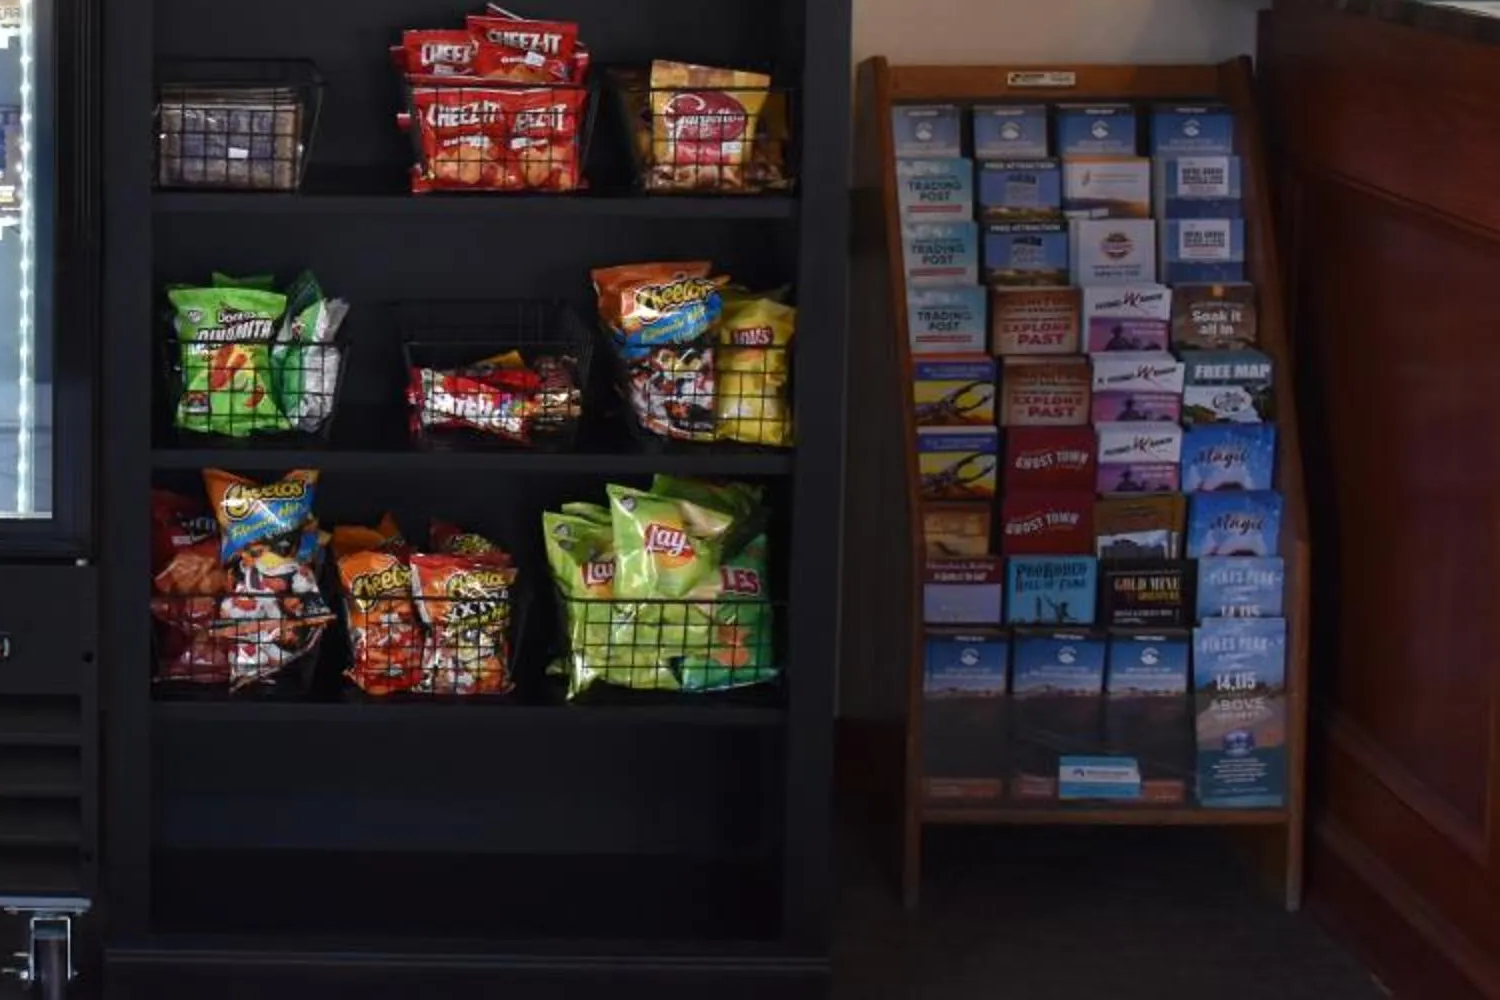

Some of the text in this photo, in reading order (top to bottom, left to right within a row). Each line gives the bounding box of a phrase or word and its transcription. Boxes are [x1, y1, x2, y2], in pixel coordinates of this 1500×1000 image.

[908, 180, 962, 191] TRADING
[918, 191, 951, 201] POST
[911, 244, 965, 254] TRADING
[921, 255, 955, 265] POST
[917, 311, 972, 321] TRADING
[1192, 309, 1242, 322] Soak it
[928, 322, 960, 332] POST
[1197, 324, 1217, 336] all
[1017, 334, 1064, 345] PAST
[1194, 364, 1272, 379] FREE MAP
[1028, 406, 1077, 418] PAST
[1015, 450, 1089, 470] GHOST TOWN
[224, 479, 307, 520] Cheetos
[1005, 511, 1080, 535] GHOST TOWN
[647, 524, 688, 557] Lay
[352, 565, 412, 606] Cheeto
[1211, 700, 1265, 711] ABOVE
